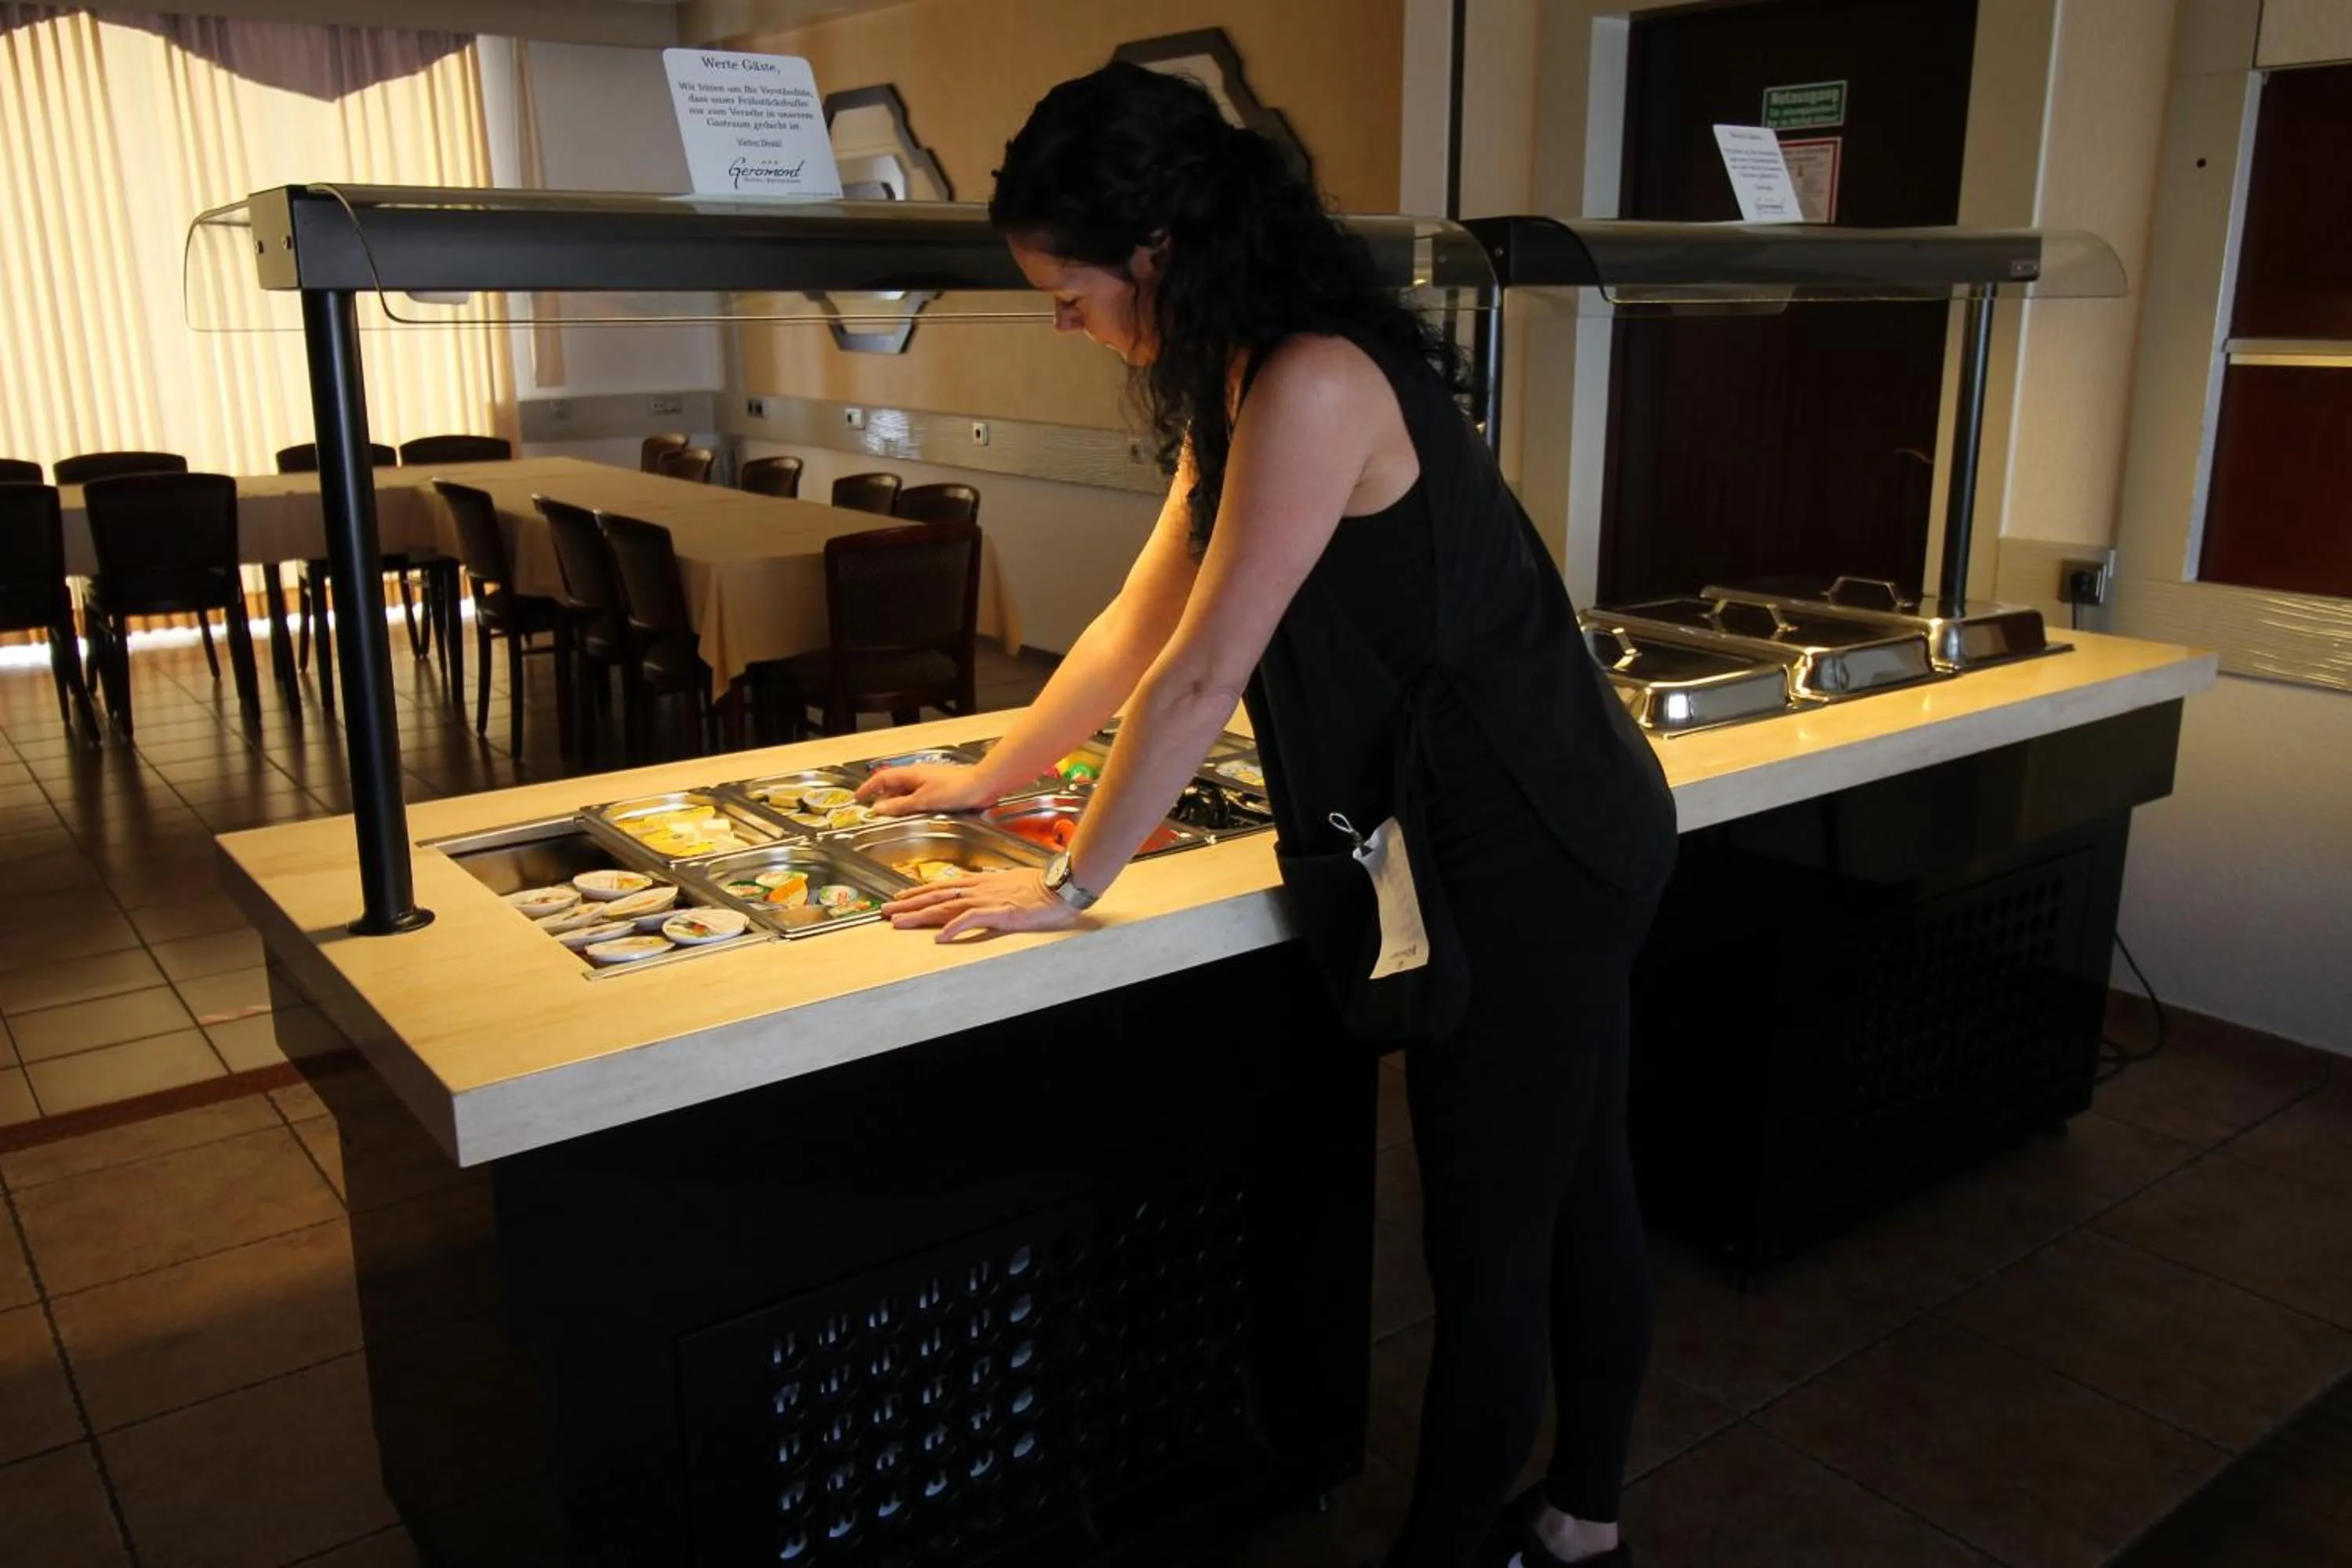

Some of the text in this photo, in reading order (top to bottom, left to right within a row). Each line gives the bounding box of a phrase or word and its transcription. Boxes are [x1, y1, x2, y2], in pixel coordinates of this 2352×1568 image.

[702, 56, 781, 75] Werte Gäste,
[678, 81, 695, 91] Wir
[698, 82, 725, 92] bitten
[744, 85, 757, 94] Ihr
[688, 93, 708, 103] dass
[710, 96, 735, 105] unser
[729, 107, 764, 118] Verzehr
[706, 117, 751, 128] Gastraum
[753, 120, 786, 131] gedacht
